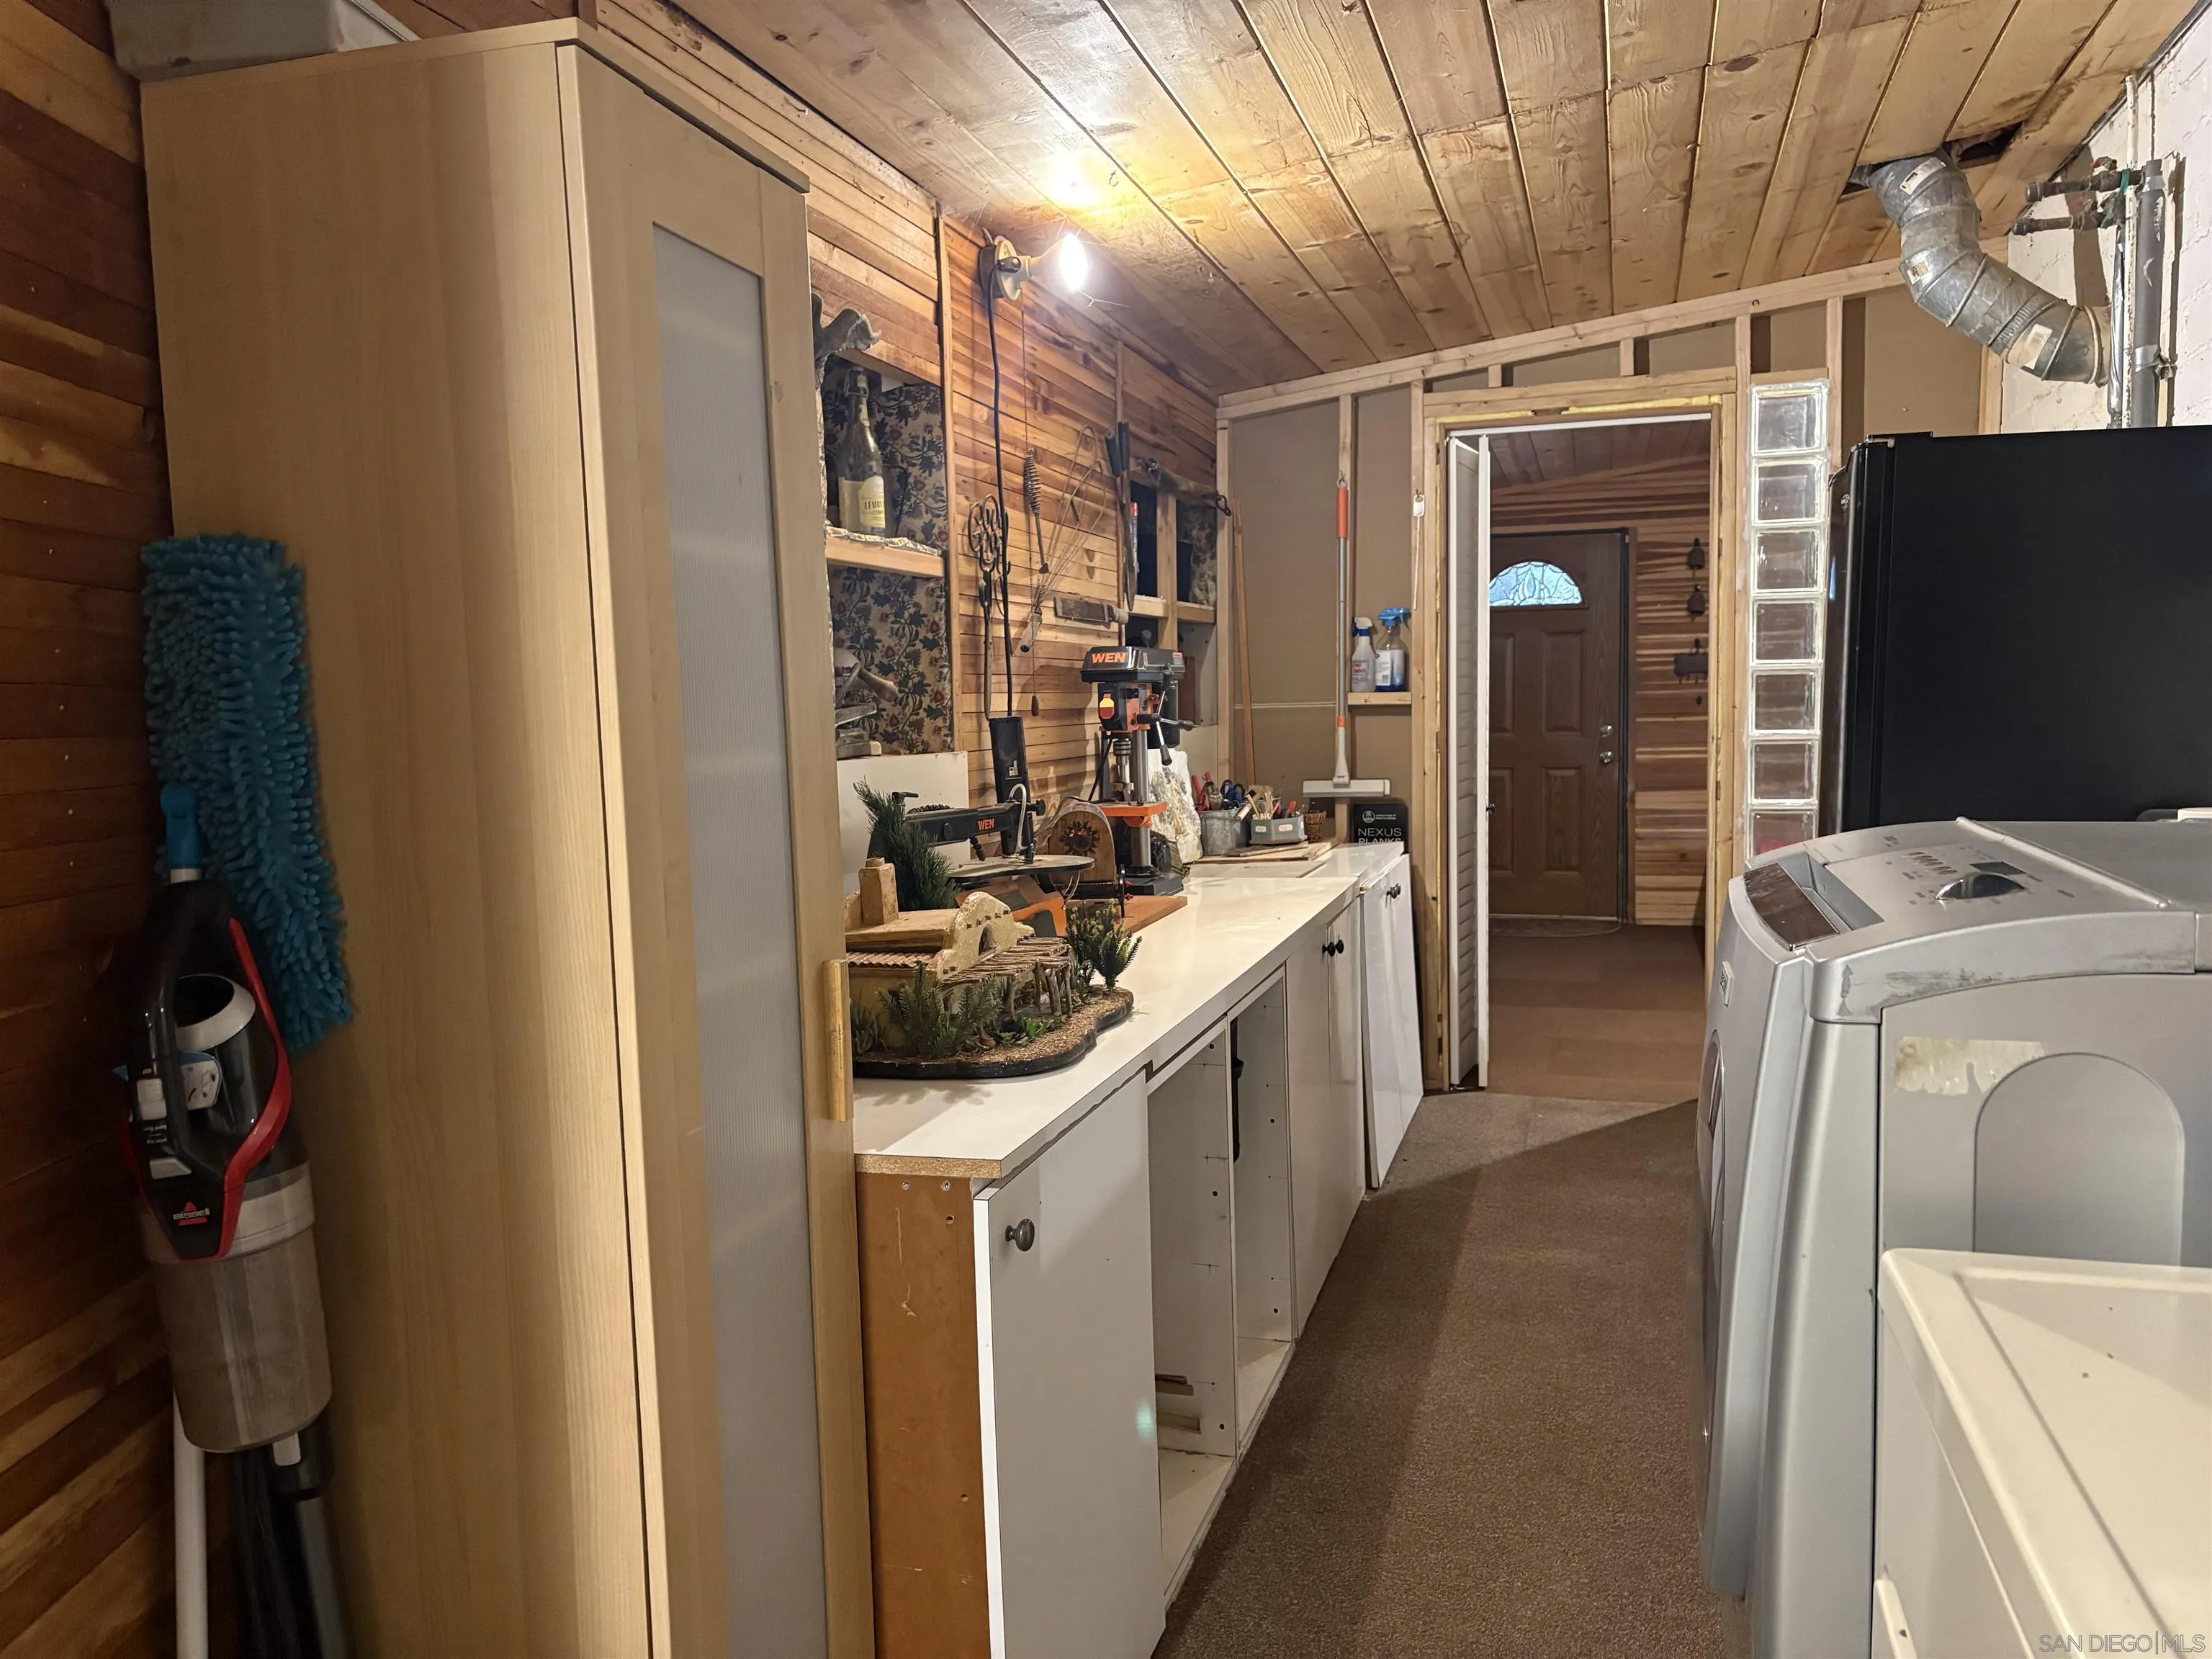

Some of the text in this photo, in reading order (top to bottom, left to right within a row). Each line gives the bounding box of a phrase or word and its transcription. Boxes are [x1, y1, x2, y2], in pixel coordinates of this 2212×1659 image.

[1092, 652, 1125, 663] WEN
[978, 818, 994, 830] WEN
[1357, 827, 1402, 837] NEXUS
